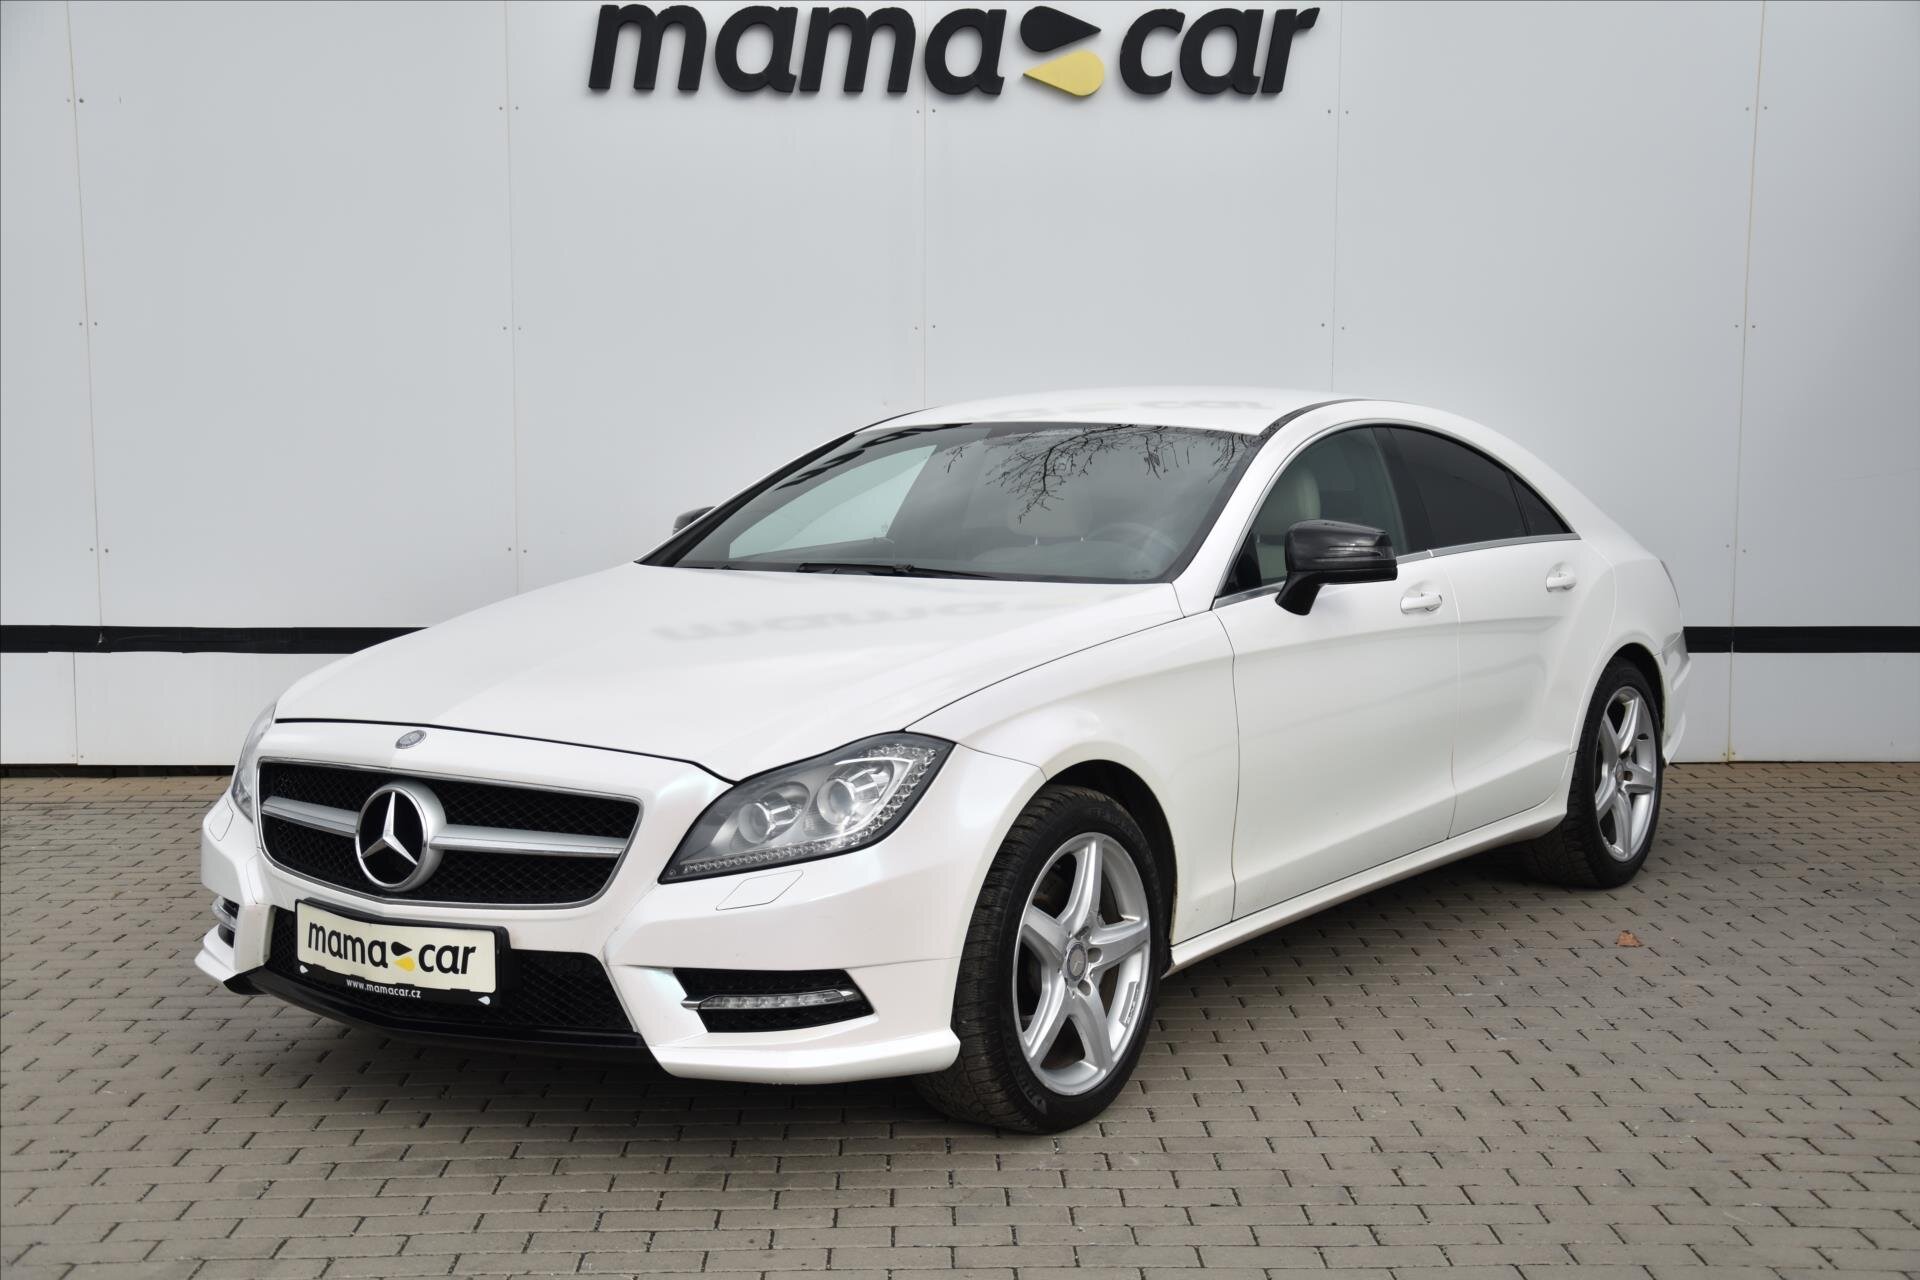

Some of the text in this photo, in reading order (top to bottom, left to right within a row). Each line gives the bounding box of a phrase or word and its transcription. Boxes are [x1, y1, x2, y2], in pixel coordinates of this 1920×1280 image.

[588, 4, 1320, 96] mama car
[307, 921, 476, 975] mama car
[346, 978, 421, 999] www.mamacar.cz
